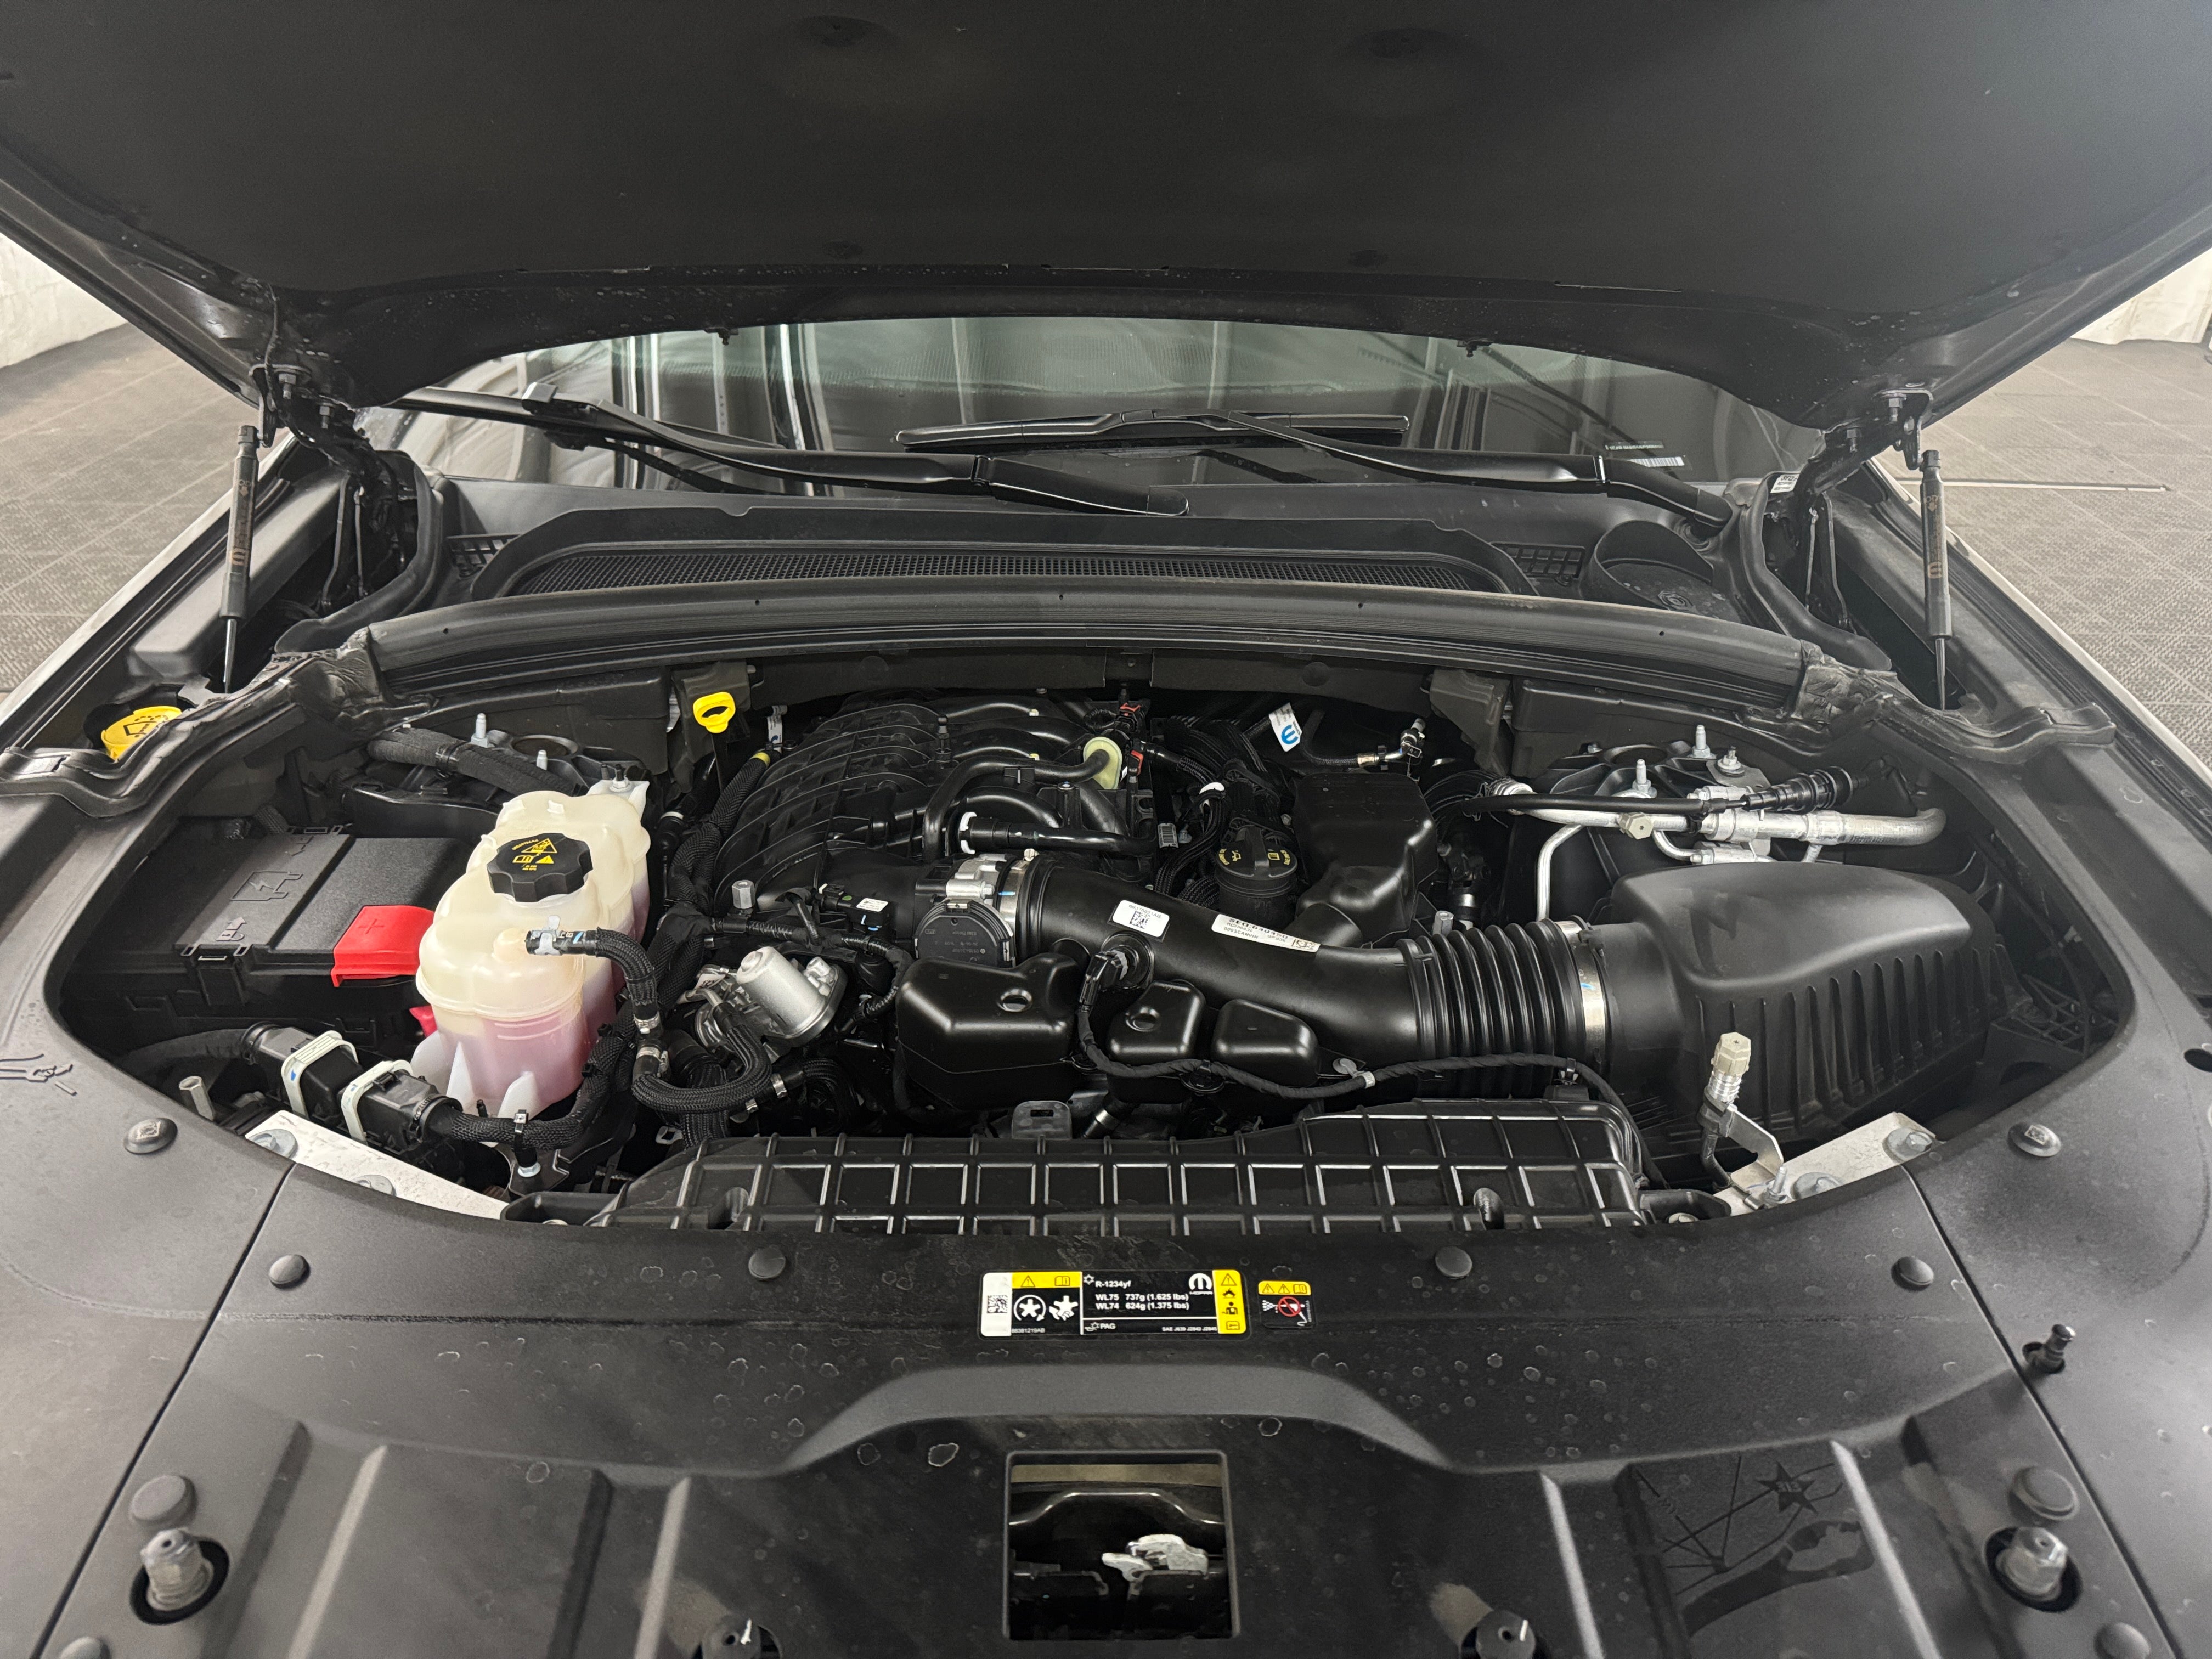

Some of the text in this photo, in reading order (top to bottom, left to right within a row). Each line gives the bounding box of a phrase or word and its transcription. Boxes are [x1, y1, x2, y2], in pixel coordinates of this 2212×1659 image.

[1095, 1280, 1132, 1289] R-1234yf
[1125, 1294, 1146, 1302] 737g
[1147, 1293, 1171, 1302] (1.625
[1173, 1293, 1189, 1302] lbs)
[1125, 1302, 1146, 1311] 624g
[1147, 1302, 1172, 1311] (1.375
[1173, 1302, 1190, 1310] lbs)
